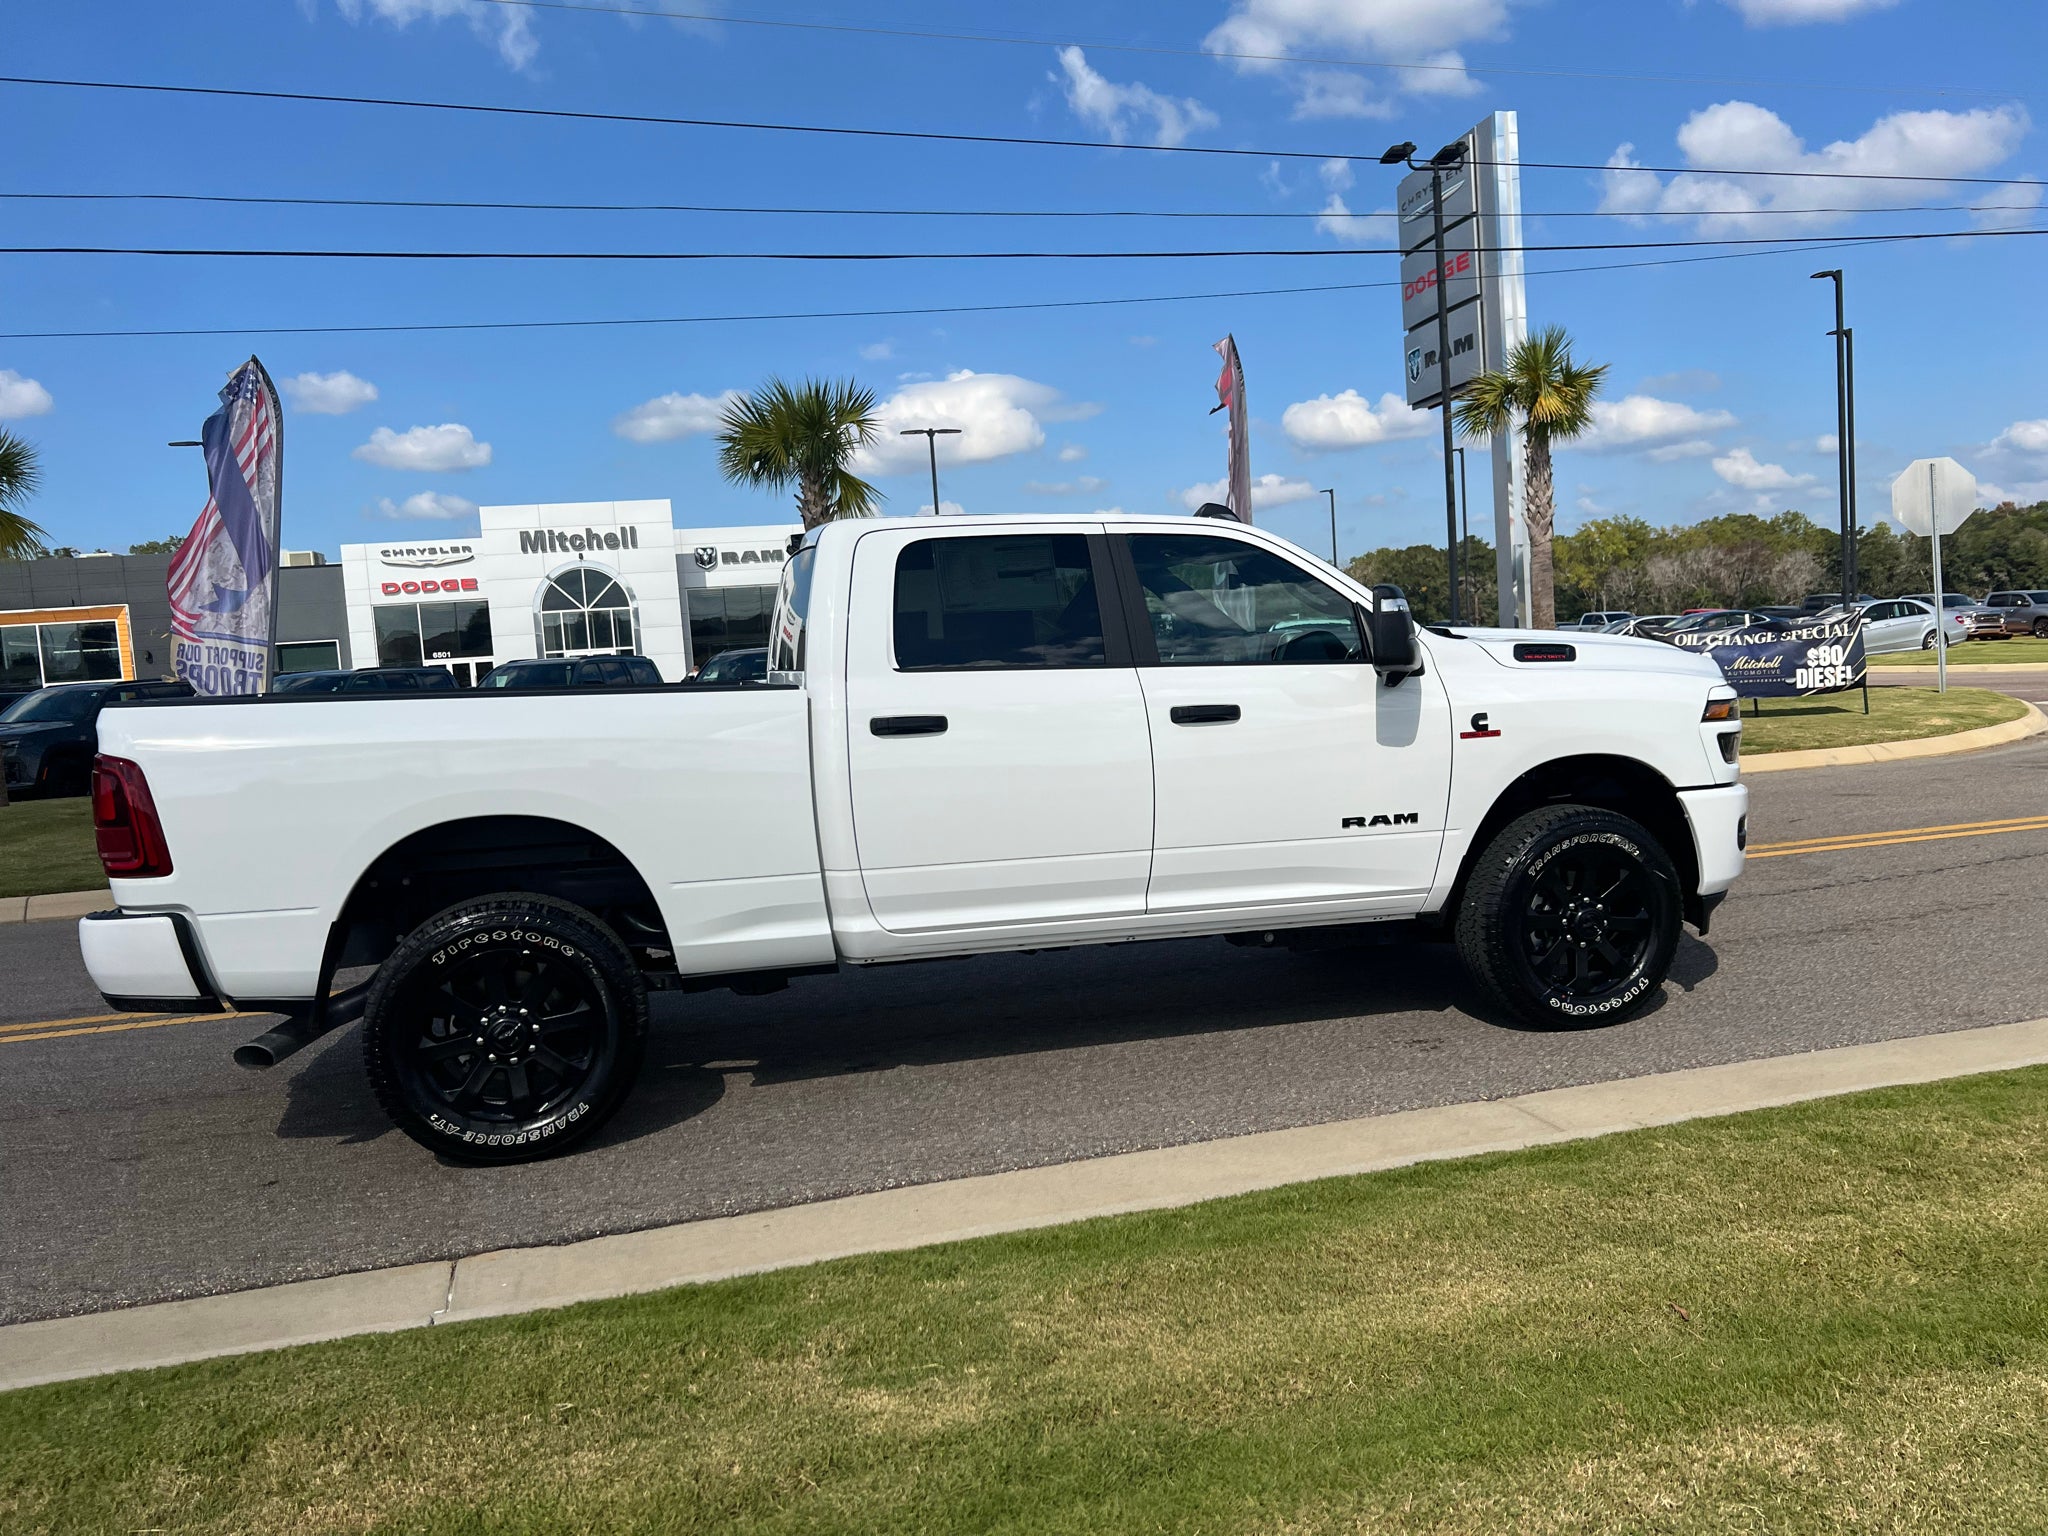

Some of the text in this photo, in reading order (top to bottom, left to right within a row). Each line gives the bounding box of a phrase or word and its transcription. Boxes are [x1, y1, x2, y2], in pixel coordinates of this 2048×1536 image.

[1401, 169, 1464, 212] CHRYSE
[1404, 251, 1470, 302] DODGE
[380, 545, 473, 557] CHRYSLER
[519, 525, 639, 554] Mitchell
[721, 549, 784, 566] RAM
[381, 578, 479, 596] DODGE
[1674, 623, 1854, 647] OIL CHANGE SPECIAL
[432, 651, 451, 659] 6501
[1724, 655, 1784, 671] Mitchell
[1806, 644, 1844, 668] $80
[1727, 669, 1781, 677] AUTOMOTIVE
[1795, 664, 1856, 690] DIESEL
[1341, 812, 1419, 829] RAM
[1527, 833, 1615, 876] TRANSFORCE
[462, 1101, 590, 1146] TRANSFORCE
